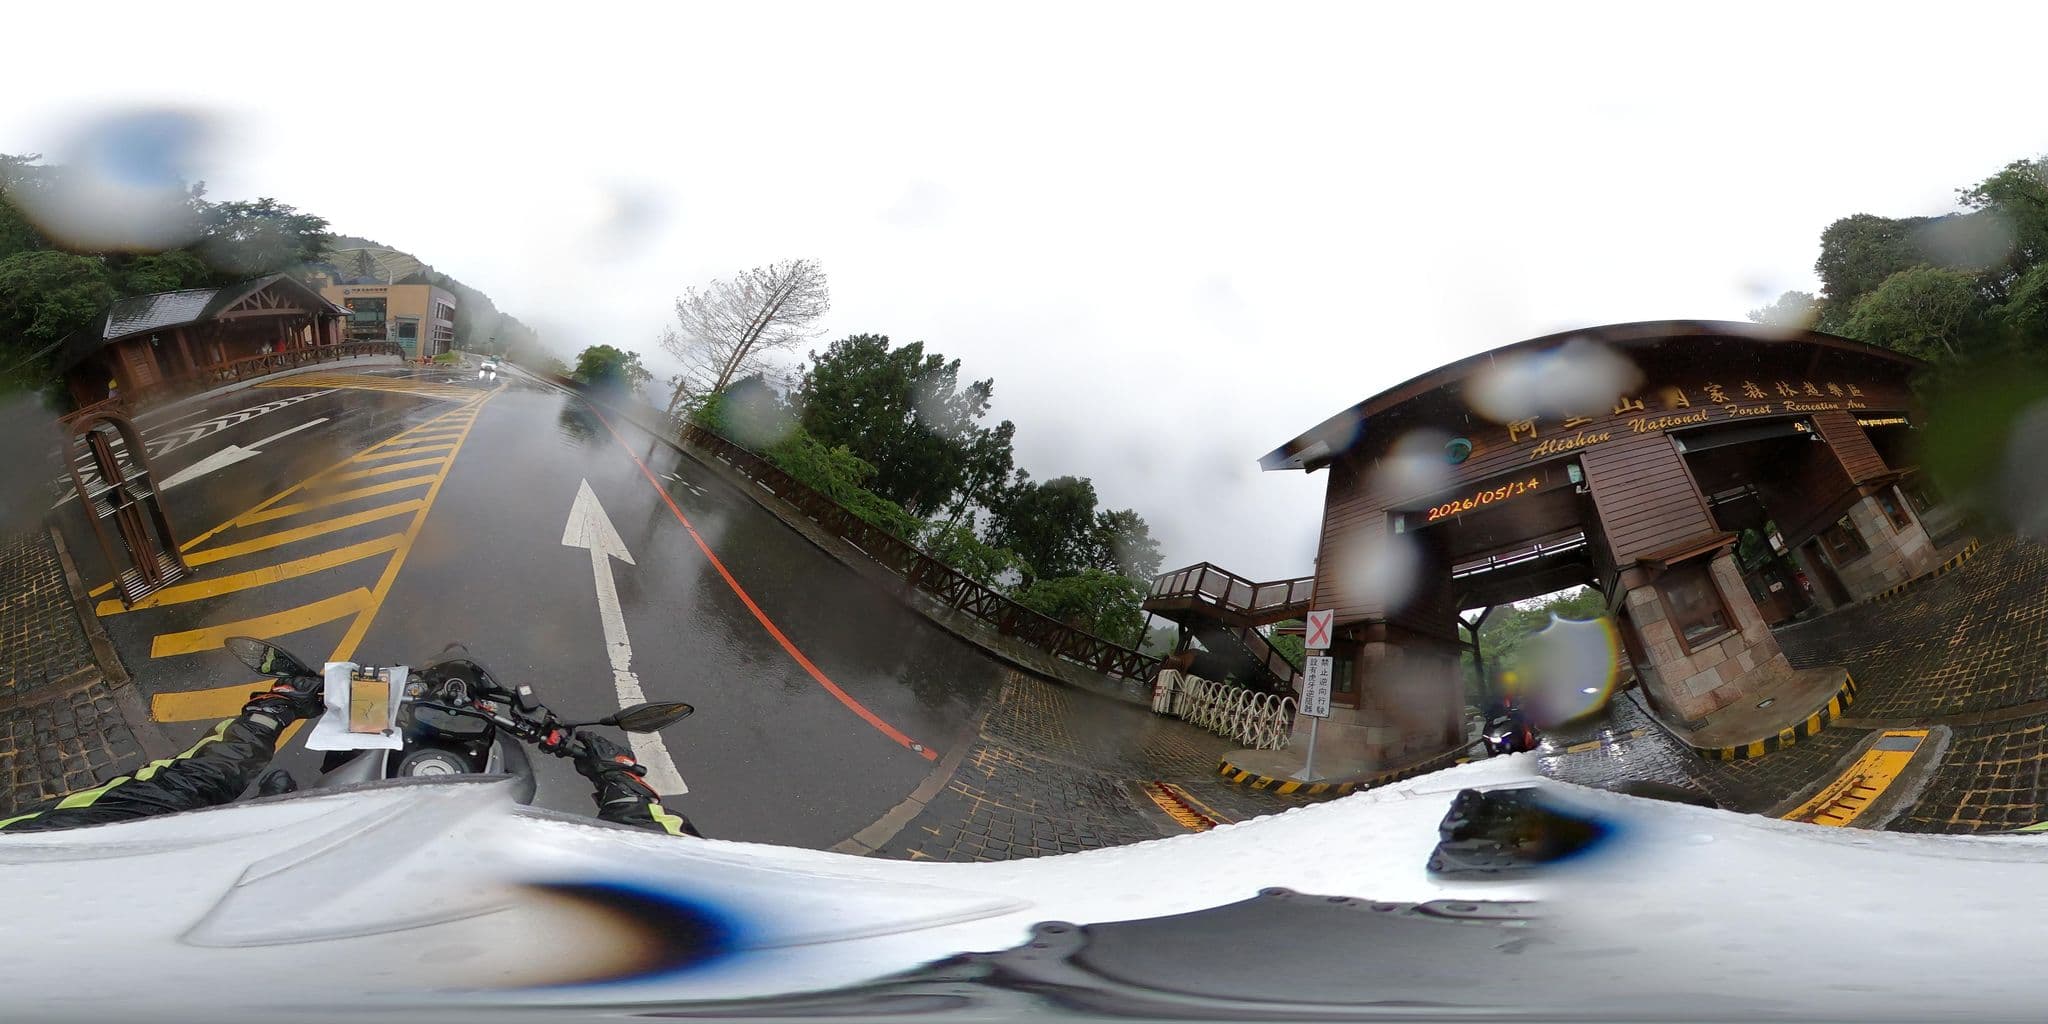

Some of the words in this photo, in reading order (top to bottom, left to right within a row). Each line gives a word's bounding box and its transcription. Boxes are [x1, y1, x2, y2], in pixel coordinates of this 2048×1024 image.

[1530, 431, 1611, 460] Alishan
[1628, 409, 1709, 433] National
[1725, 404, 1773, 418] Forest
[1783, 399, 1840, 412] Recreation
[1847, 399, 1867, 410] Area
[1428, 477, 1540, 522] 2026/05/14
[1316, 658, 1329, 715] 禁止逆向行駛
